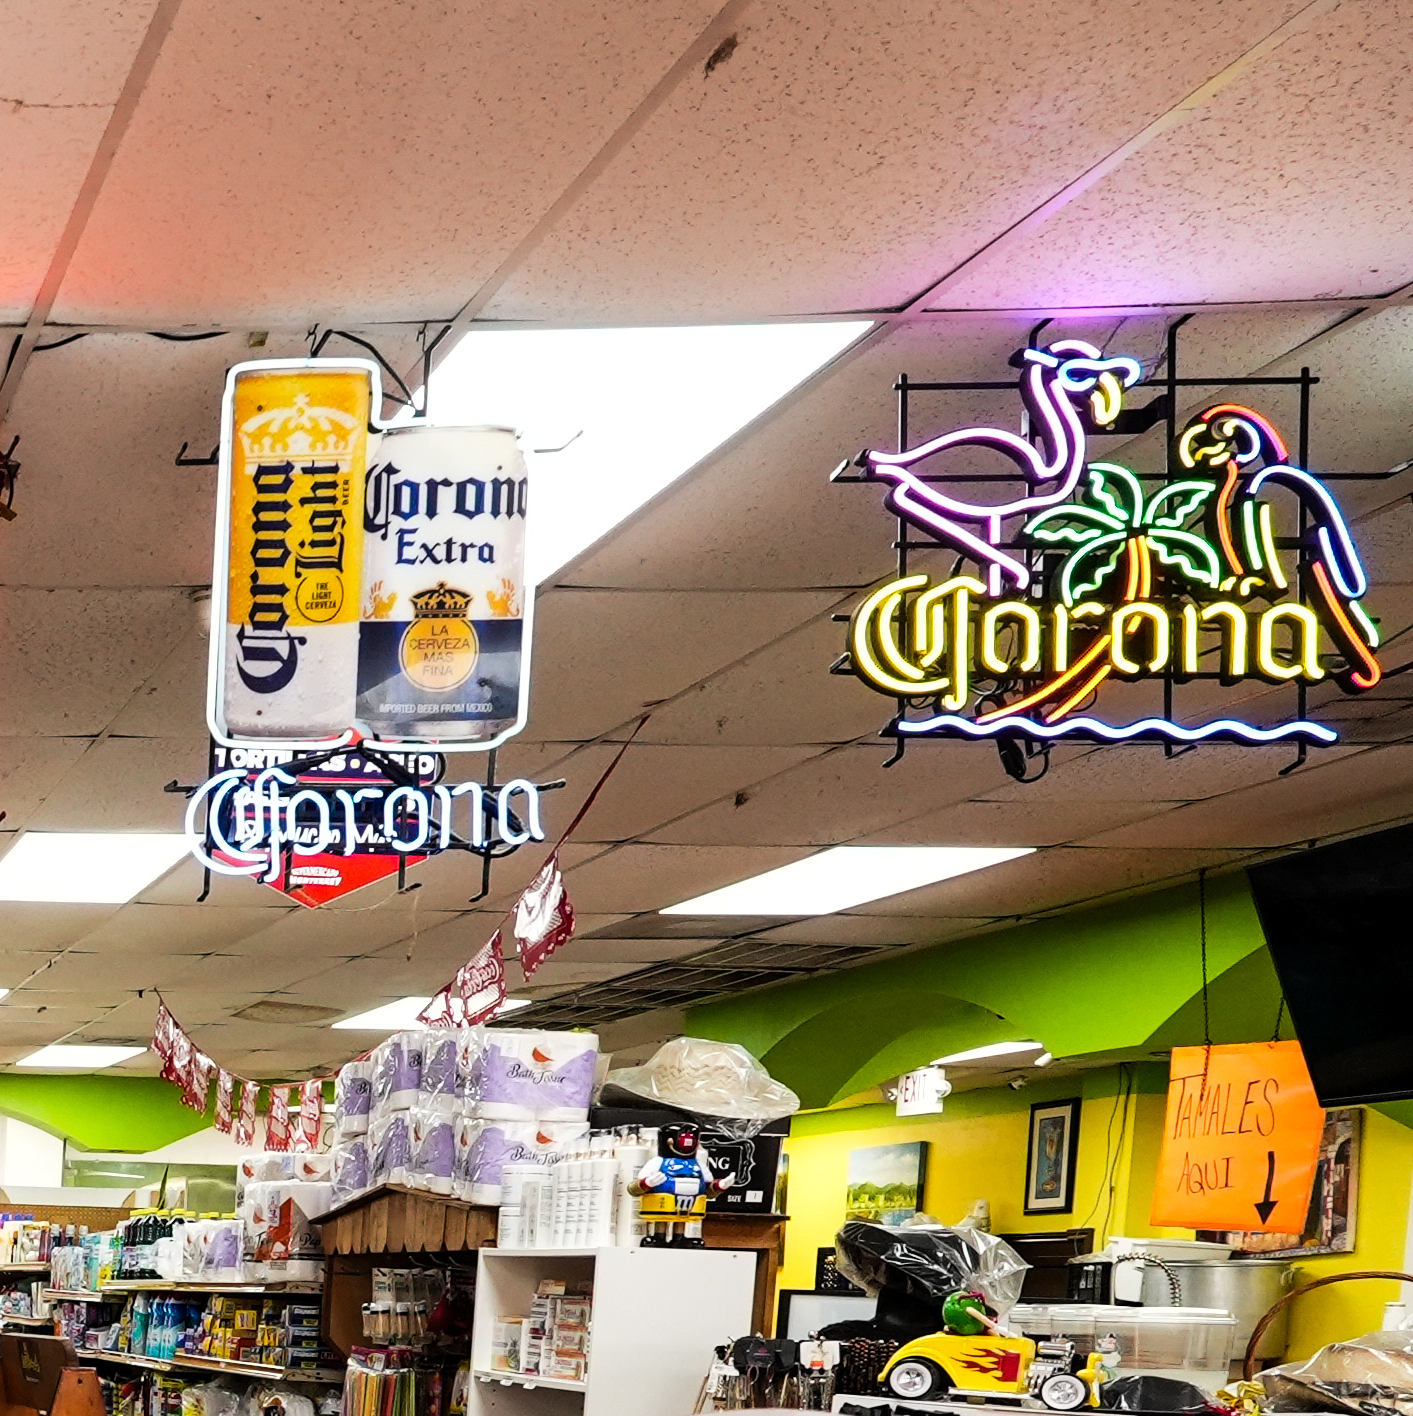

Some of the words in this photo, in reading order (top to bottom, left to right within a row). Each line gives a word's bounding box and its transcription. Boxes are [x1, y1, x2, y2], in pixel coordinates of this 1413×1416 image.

[341, 478, 350, 506] BEER
[294, 459, 347, 579] Light
[395, 527, 496, 566] Extra
[236, 460, 307, 695] Corona
[305, 600, 337, 611] CERVEZA
[311, 592, 331, 601] LIGHT
[430, 625, 450, 637] LA
[409, 637, 471, 651] CERVEZA
[853, 575, 1324, 711] Corona
[423, 651, 454, 664] MAS
[422, 665, 454, 677] FINA
[379, 703, 416, 714] IMPORTED
[417, 703, 439, 714] BEER
[440, 702, 465, 714] FROM
[465, 702, 493, 714] MEXICO
[184, 768, 546, 883] Corona
[288, 875, 343, 888] MONTERREY
[506, 1063, 534, 1081] Bath
[904, 1072, 929, 1103] EXIT
[1169, 1073, 1279, 1141] TAMALES
[1177, 1155, 1236, 1197] AQUI
